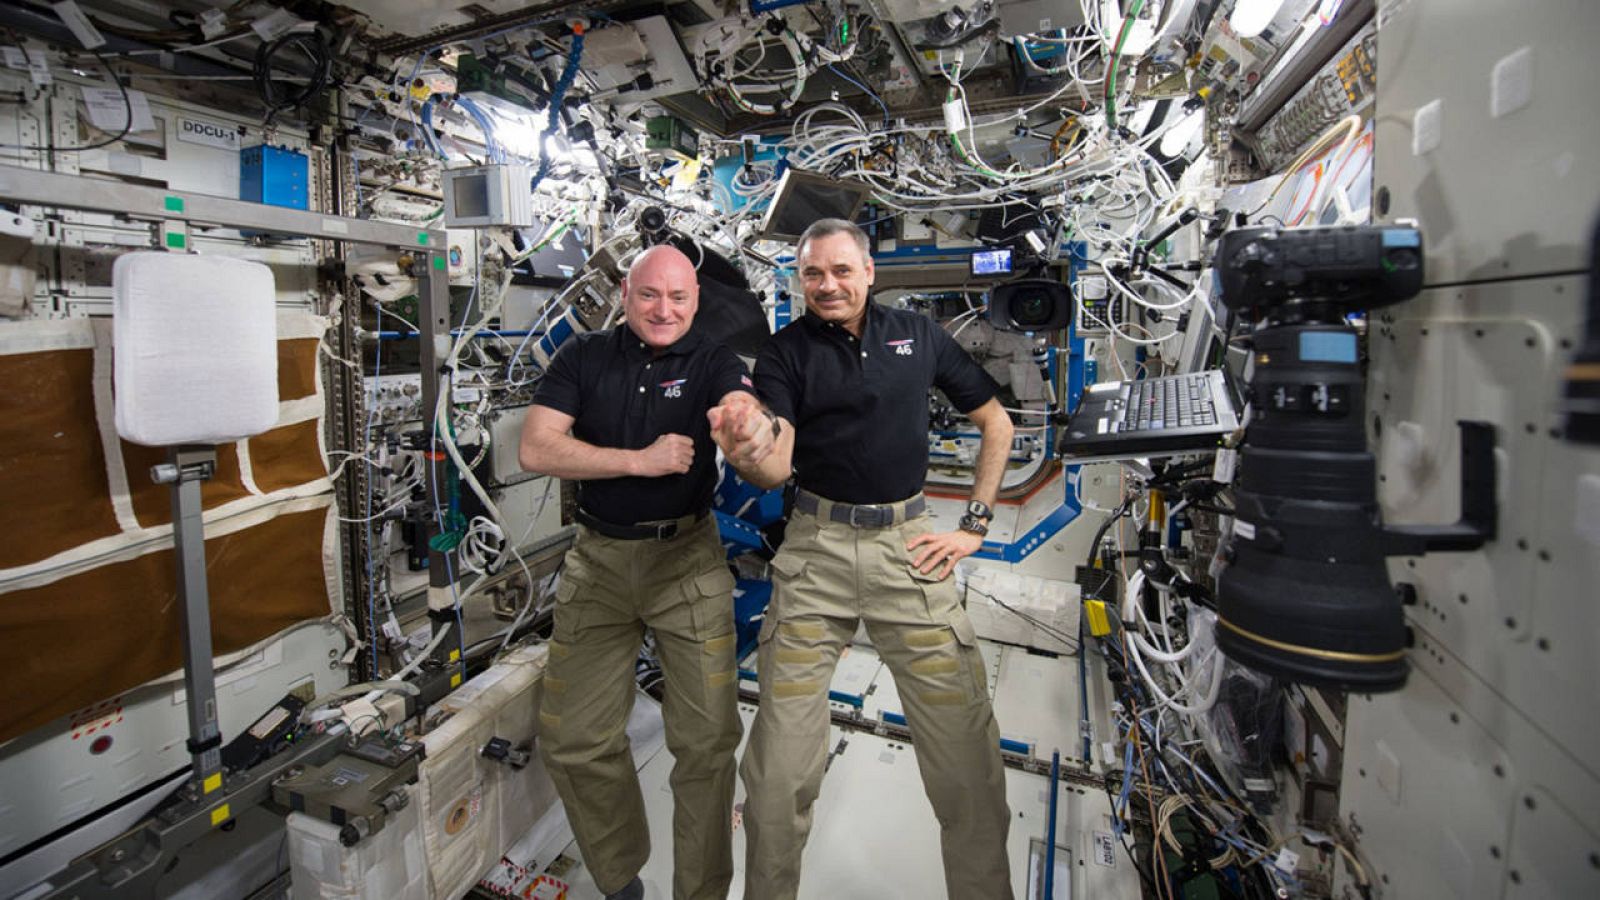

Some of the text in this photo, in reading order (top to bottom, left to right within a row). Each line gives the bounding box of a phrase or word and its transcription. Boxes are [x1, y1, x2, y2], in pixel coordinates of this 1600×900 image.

[183, 120, 235, 141] DDCU-1
[895, 344, 913, 356] 46
[664, 385, 681, 399] 46
